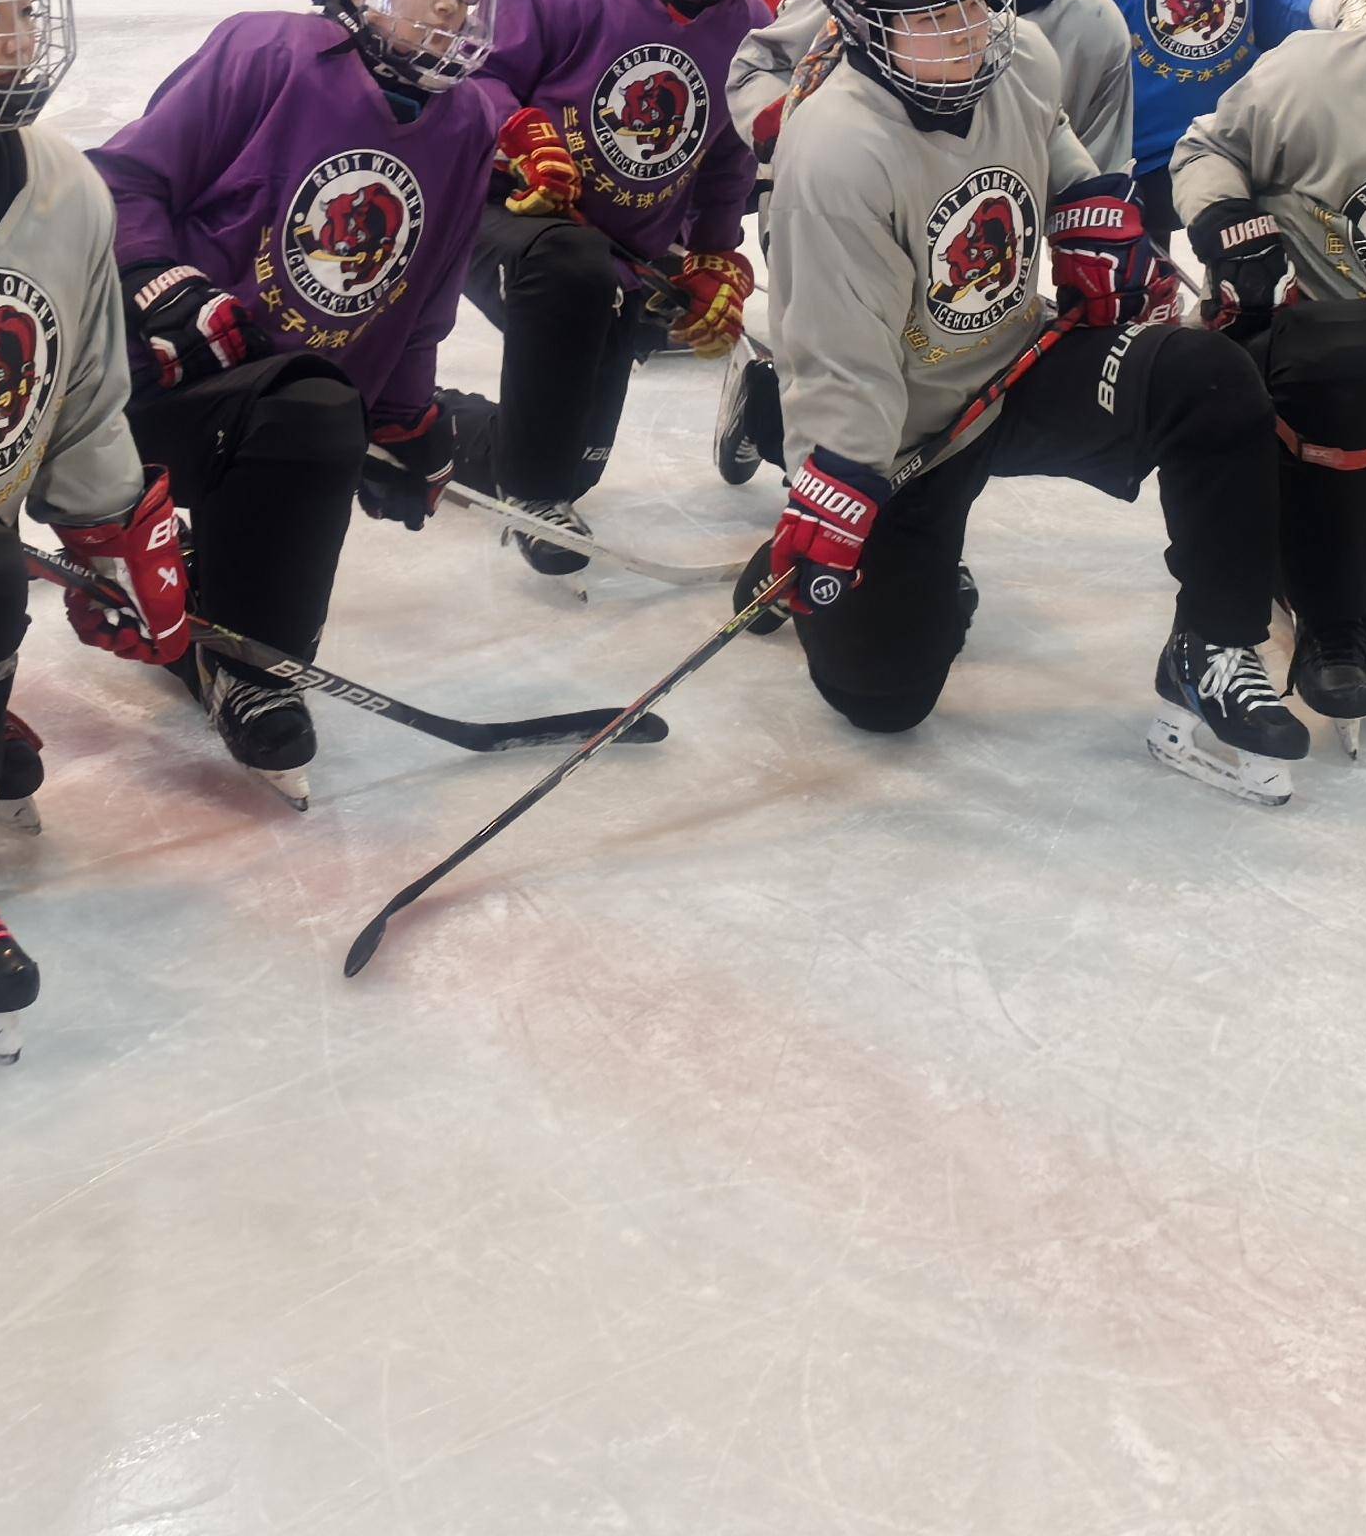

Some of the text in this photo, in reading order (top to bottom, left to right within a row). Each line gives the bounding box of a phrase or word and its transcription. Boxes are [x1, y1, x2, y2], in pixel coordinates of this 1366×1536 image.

[1224, 16, 1244, 44] CLUB
[612, 48, 707, 108] R&DT WOMEN'S
[658, 150, 688, 176] CLUB
[312, 154, 421, 229] R&DT WOMEN'S
[966, 172, 1028, 206] WOMEN'S
[265, 659, 392, 714] BAUER
